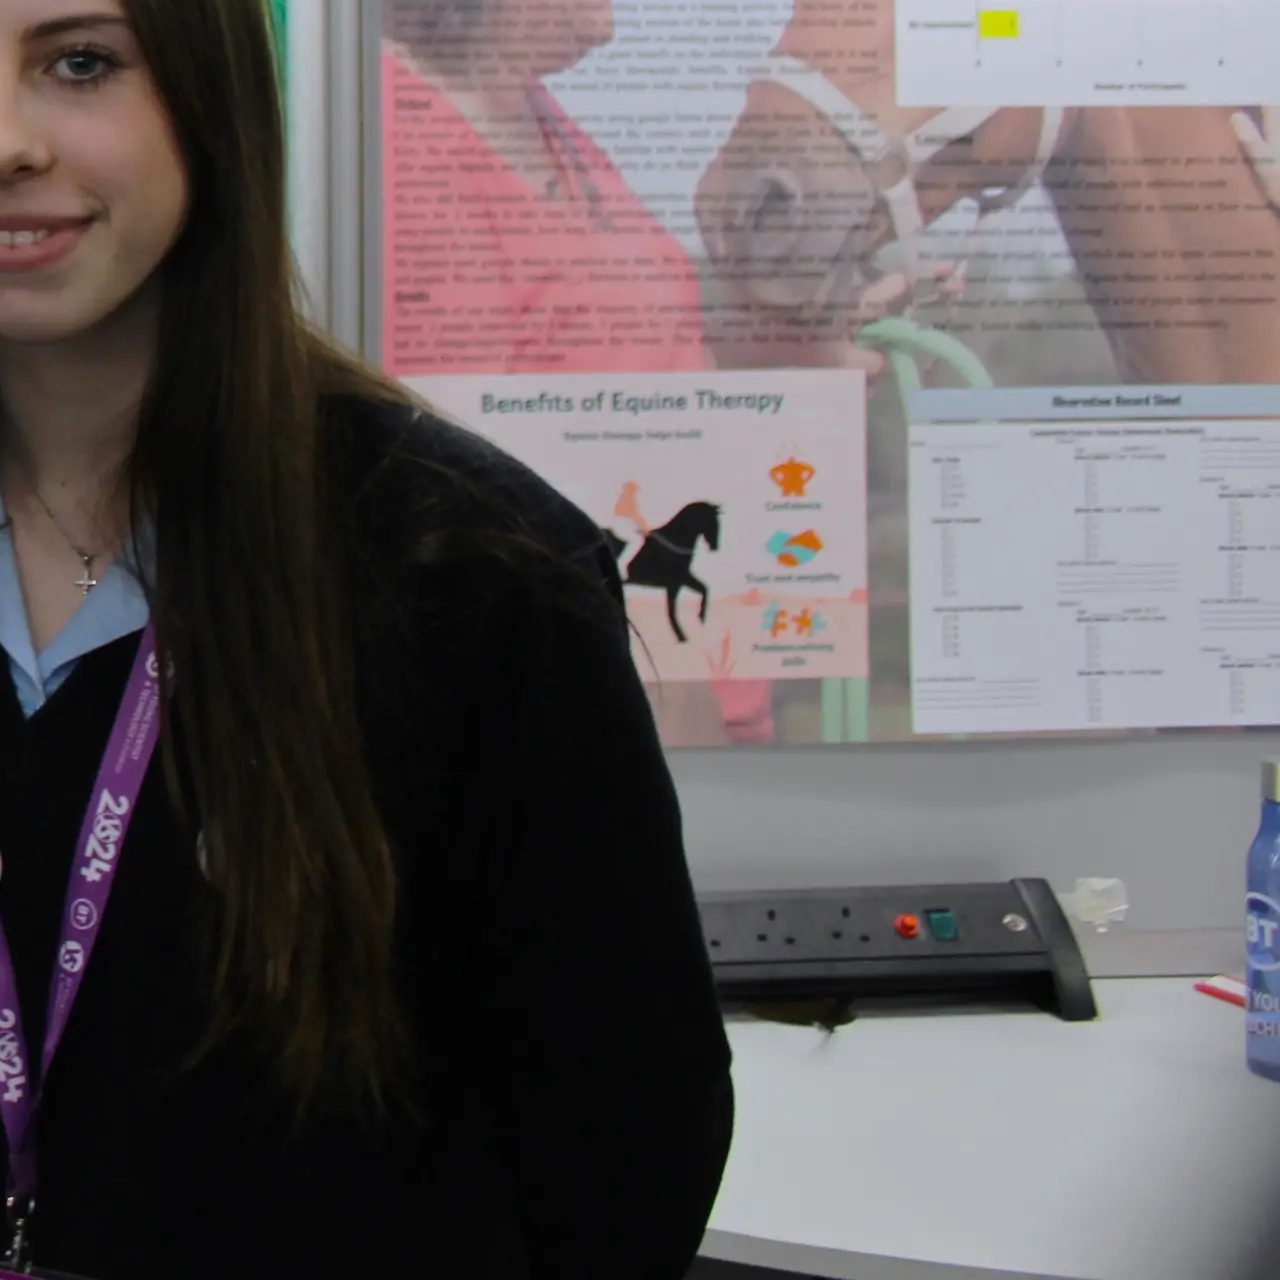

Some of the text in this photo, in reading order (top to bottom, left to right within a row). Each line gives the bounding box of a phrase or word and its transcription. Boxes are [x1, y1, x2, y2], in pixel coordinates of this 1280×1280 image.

[481, 389, 785, 418] Benefits of Equine Therapy
